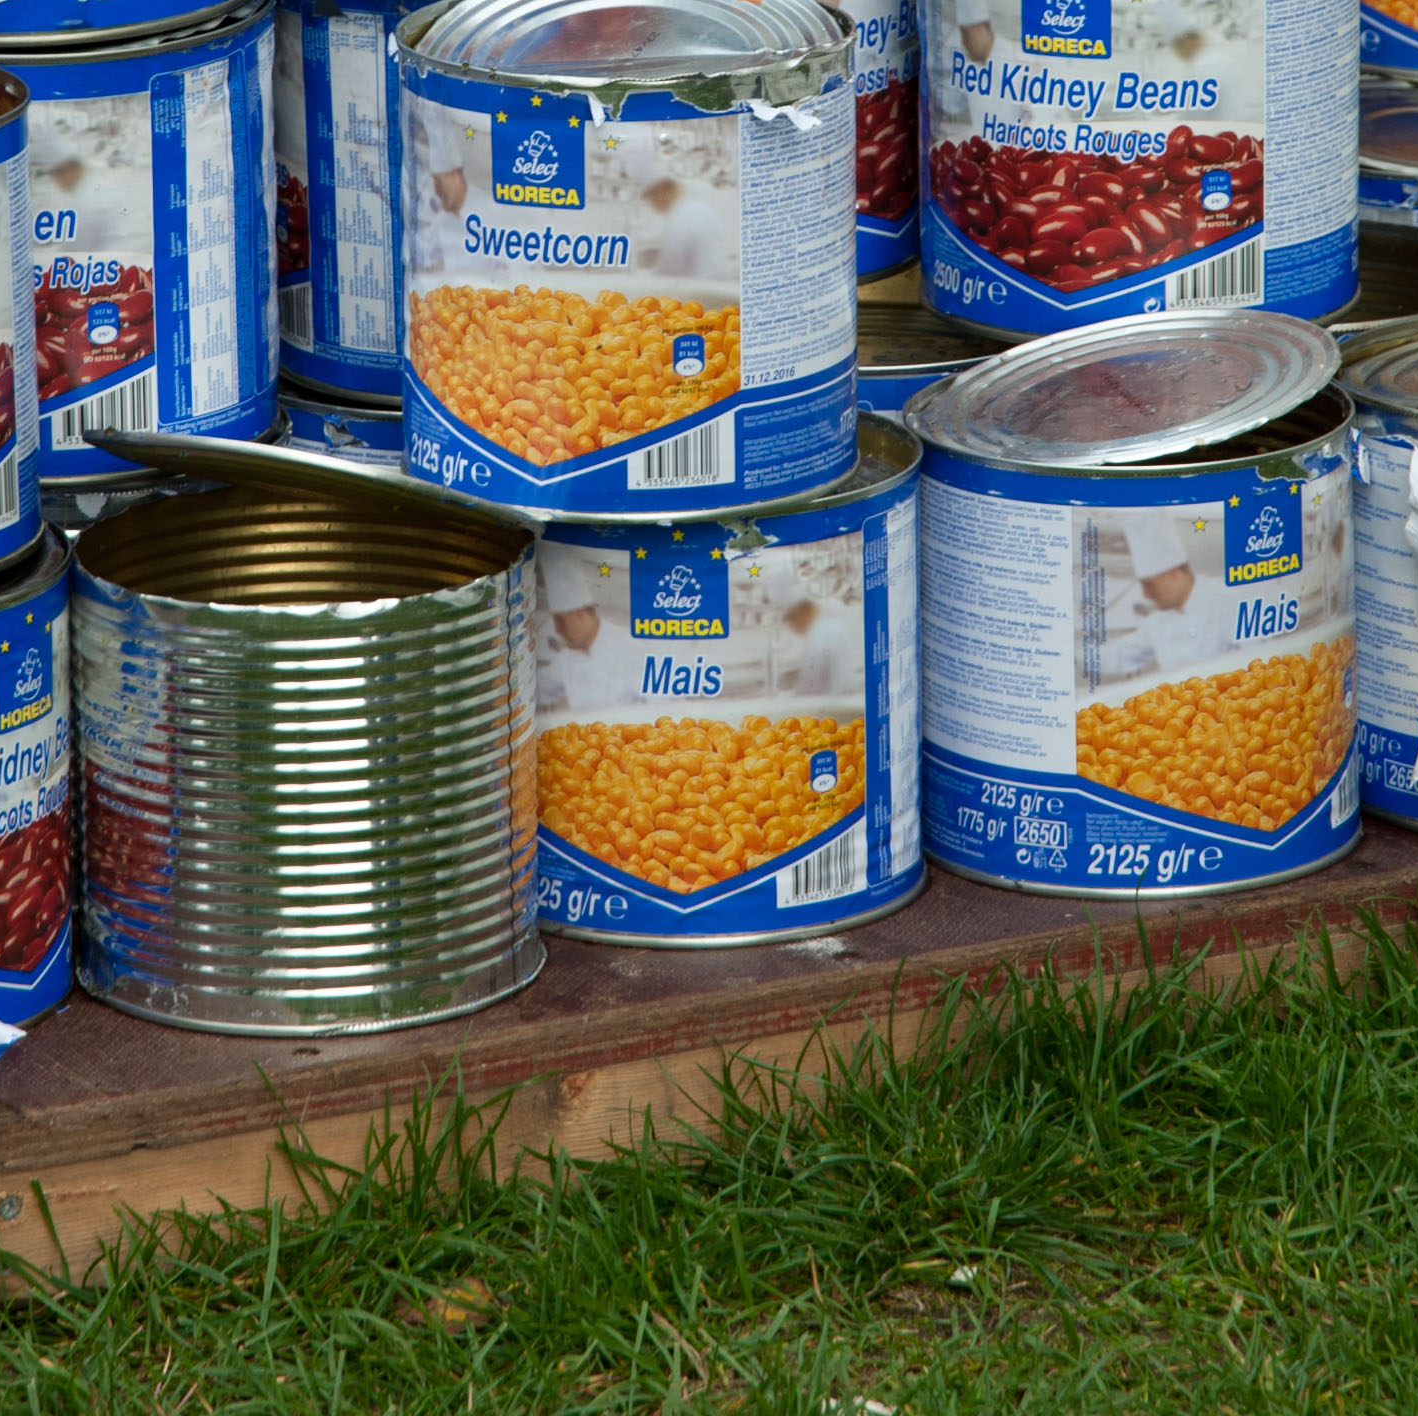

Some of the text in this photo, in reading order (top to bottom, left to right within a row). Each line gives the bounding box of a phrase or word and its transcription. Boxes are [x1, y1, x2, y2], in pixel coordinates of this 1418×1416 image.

[1041, 9, 1086, 28] Select
[1025, 34, 1107, 56] HORECA
[854, 59, 889, 95] ossi
[951, 51, 993, 96] Red
[1000, 63, 1106, 119] Kidney
[1116, 72, 1219, 110] Beans
[983, 112, 1166, 161] Haricots Rouges
[512, 157, 559, 176] Select
[495, 182, 580, 206] HORECA
[464, 213, 629, 266] Sweetcorn
[50, 255, 119, 293] Rojas
[933, 261, 960, 295] 2500
[743, 365, 796, 386] 31.12.2016
[410, 433, 440, 475] 2125
[1245, 532, 1284, 553] Select
[1229, 553, 1300, 583] HORECA
[653, 591, 702, 609] Select
[634, 618, 724, 636] HORECA
[1236, 592, 1299, 641] Mais
[642, 655, 723, 696] Mais
[0, 693, 52, 731] HORECA
[981, 782, 1017, 809] 2125
[958, 807, 984, 833] 1775
[1018, 821, 1061, 846] 2650
[1087, 844, 1150, 875] 2125
